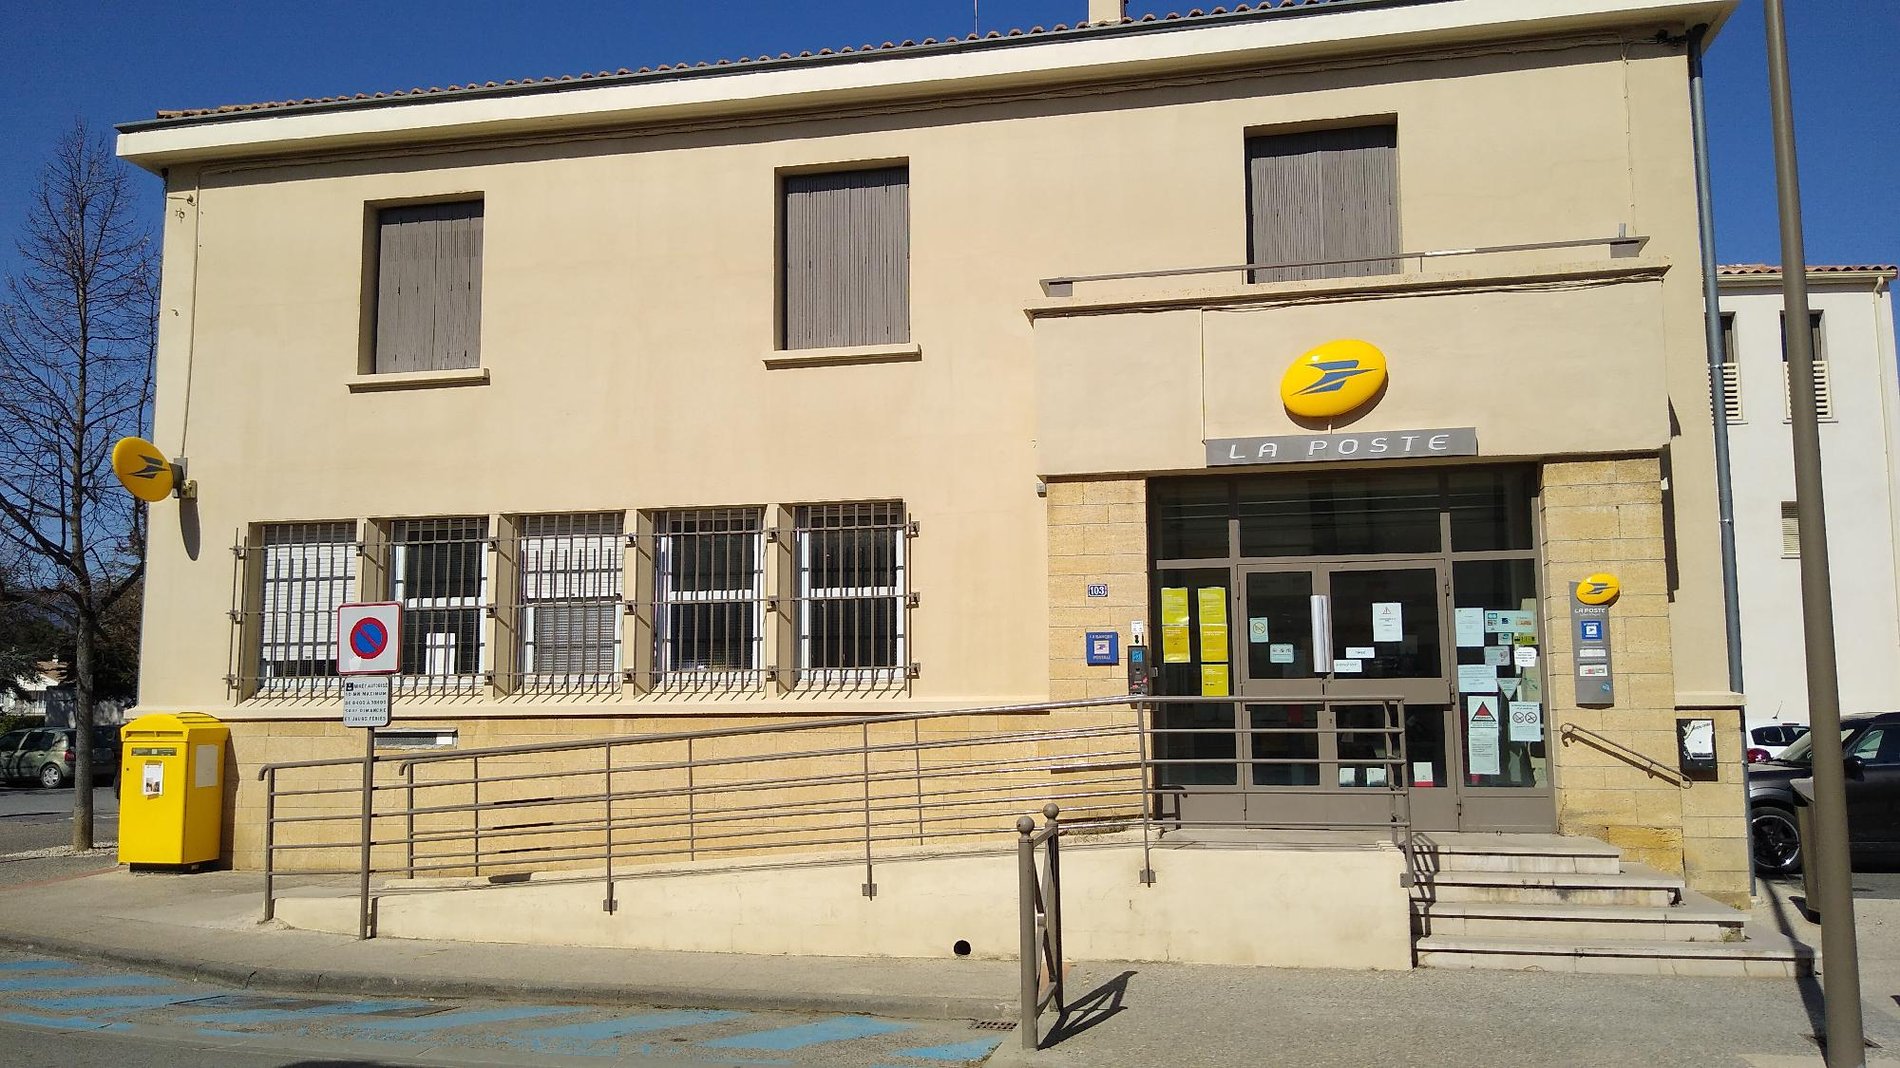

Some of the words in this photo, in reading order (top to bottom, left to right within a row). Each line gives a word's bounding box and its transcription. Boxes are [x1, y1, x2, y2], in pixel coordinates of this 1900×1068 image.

[1229, 442, 1278, 459] LA
[1308, 434, 1450, 456] POSTE
[1090, 586, 1105, 595] 103
